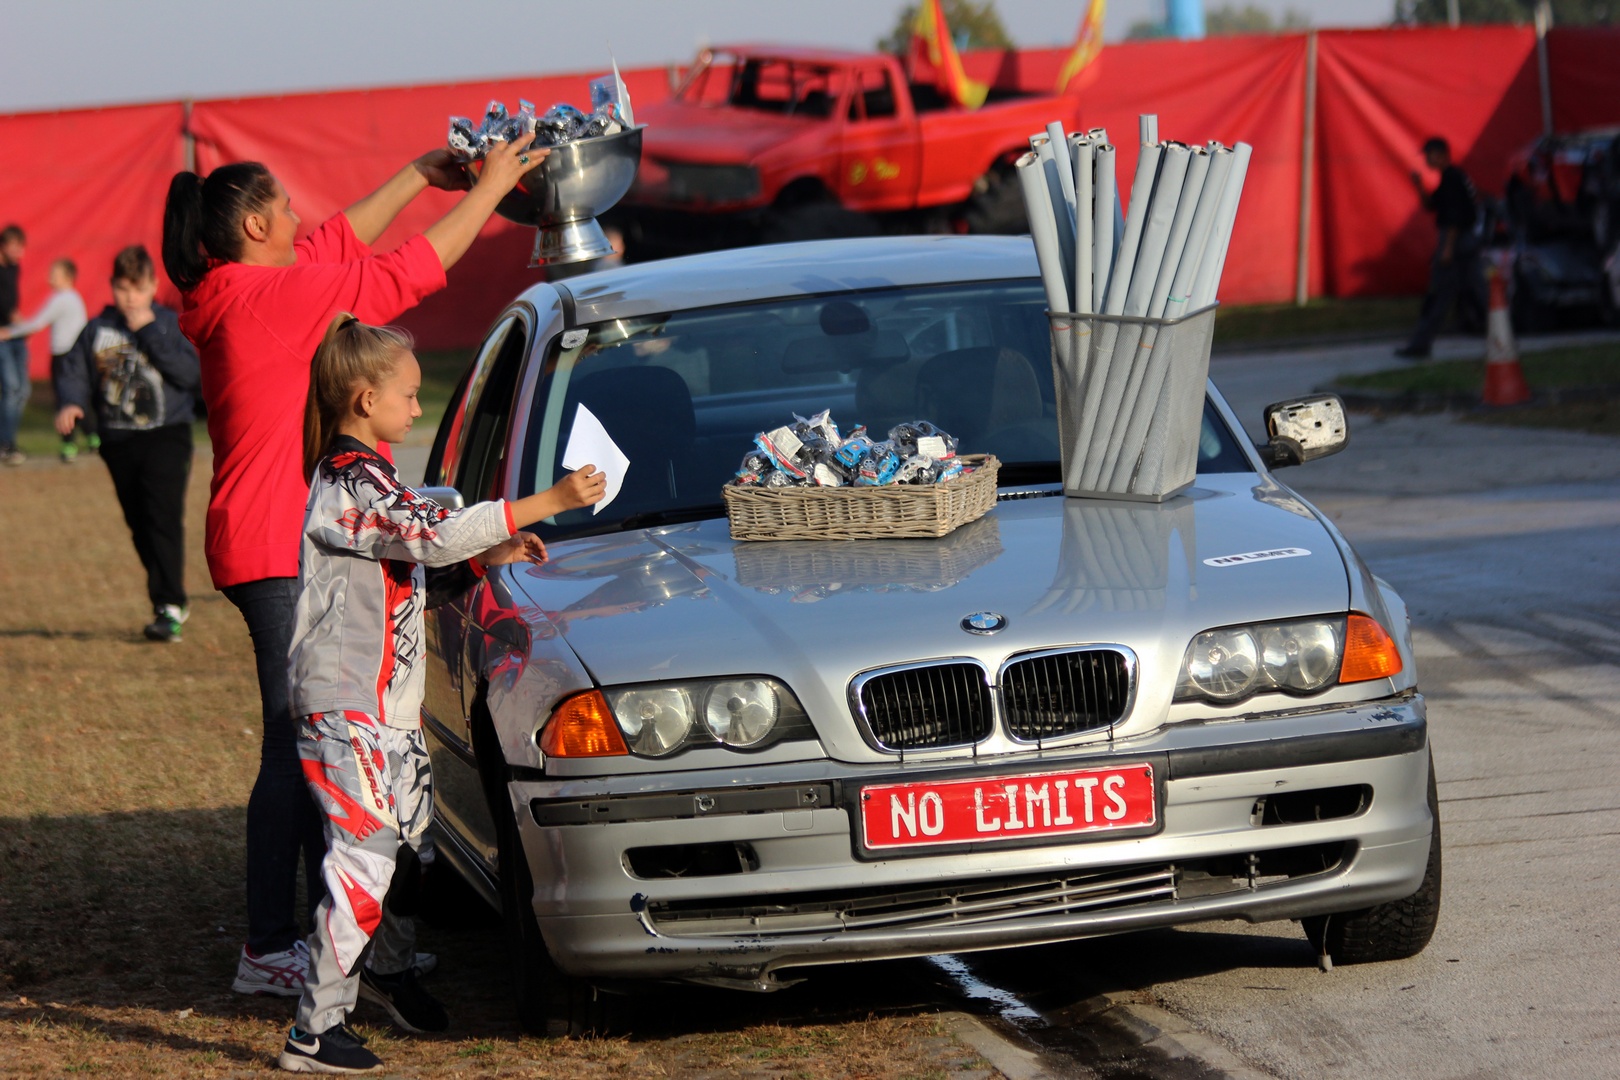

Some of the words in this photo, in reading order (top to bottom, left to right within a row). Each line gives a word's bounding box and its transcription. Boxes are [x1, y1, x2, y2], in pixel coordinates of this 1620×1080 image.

[1213, 556, 1243, 565] NO
[350, 736, 384, 810] SINISALO
[890, 791, 944, 839] NO
[974, 775, 1127, 833] LIMITS
